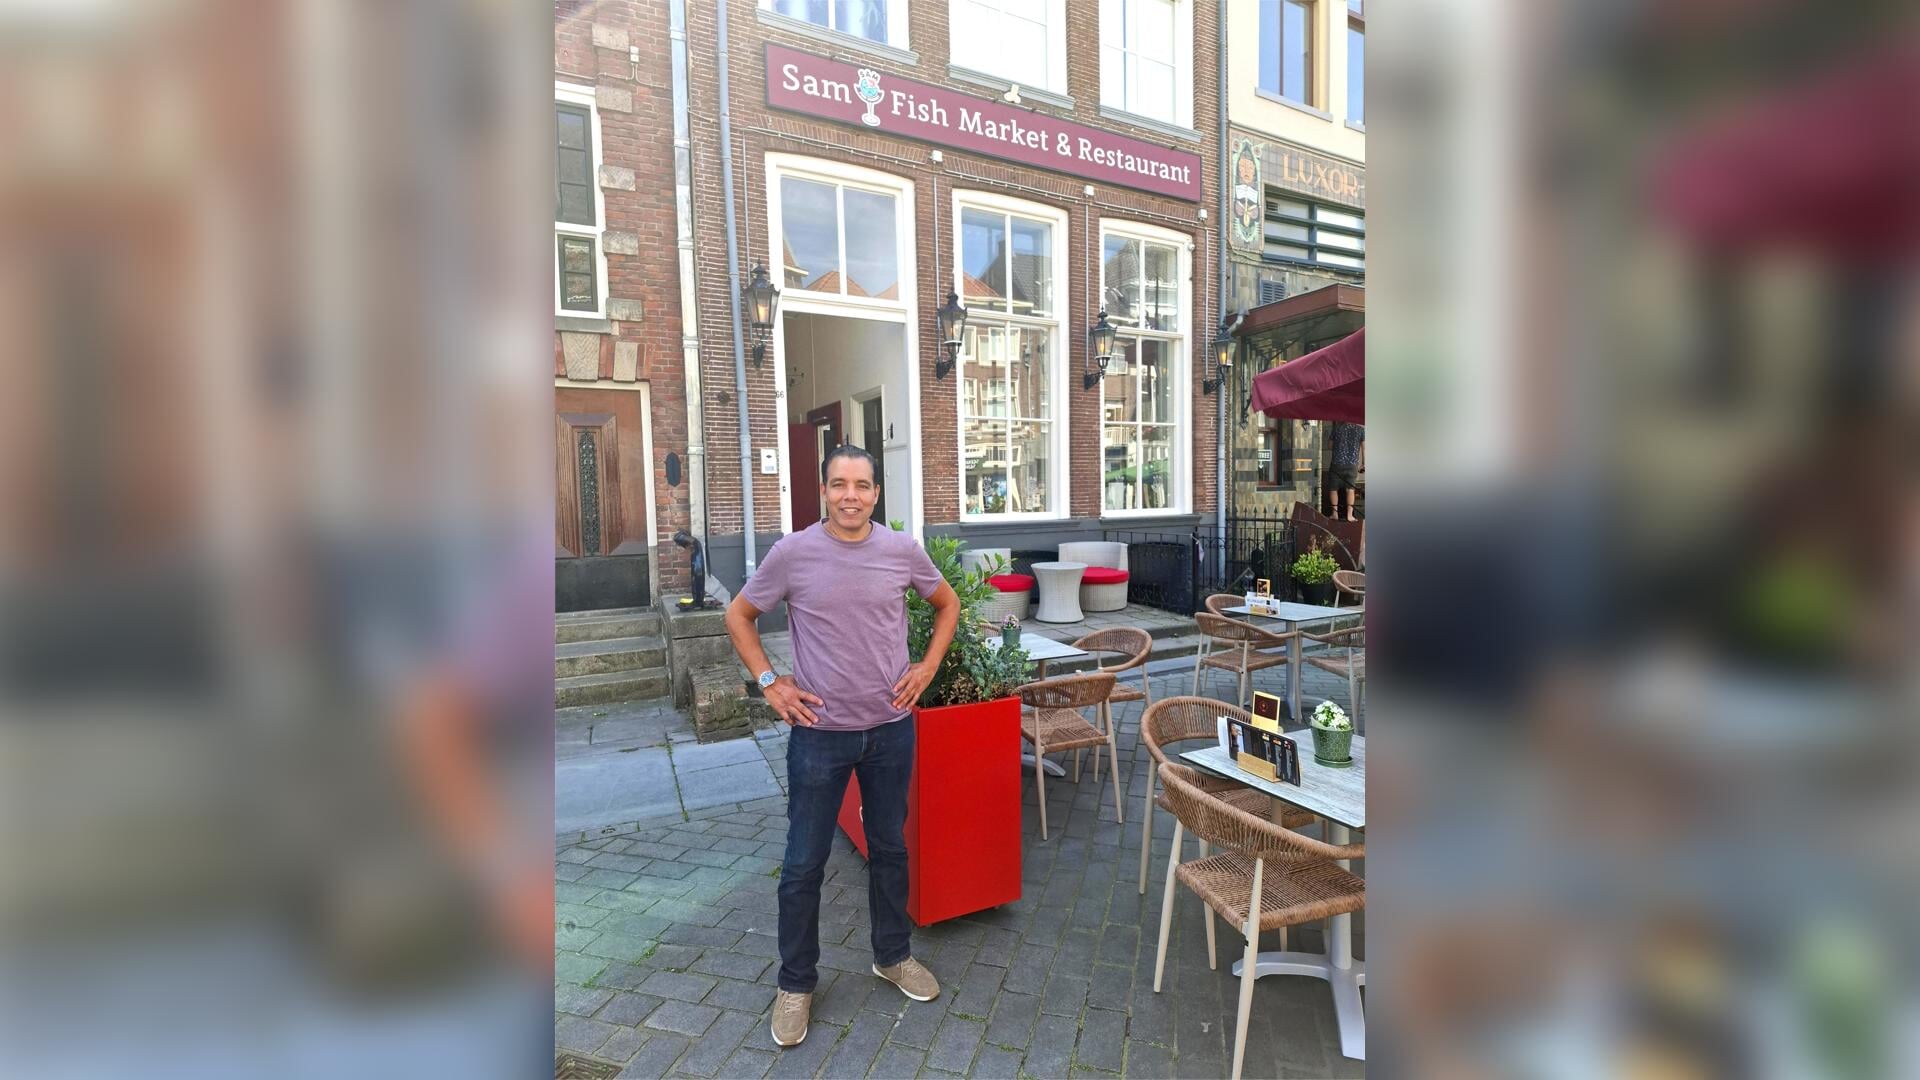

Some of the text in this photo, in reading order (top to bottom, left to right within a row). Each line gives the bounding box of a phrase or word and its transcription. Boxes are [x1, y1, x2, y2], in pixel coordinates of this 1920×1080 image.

[859, 70, 879, 80] SAM
[781, 63, 1191, 185] Sam Fish Market & Restaurant
[1282, 153, 1359, 198] LUXOR
